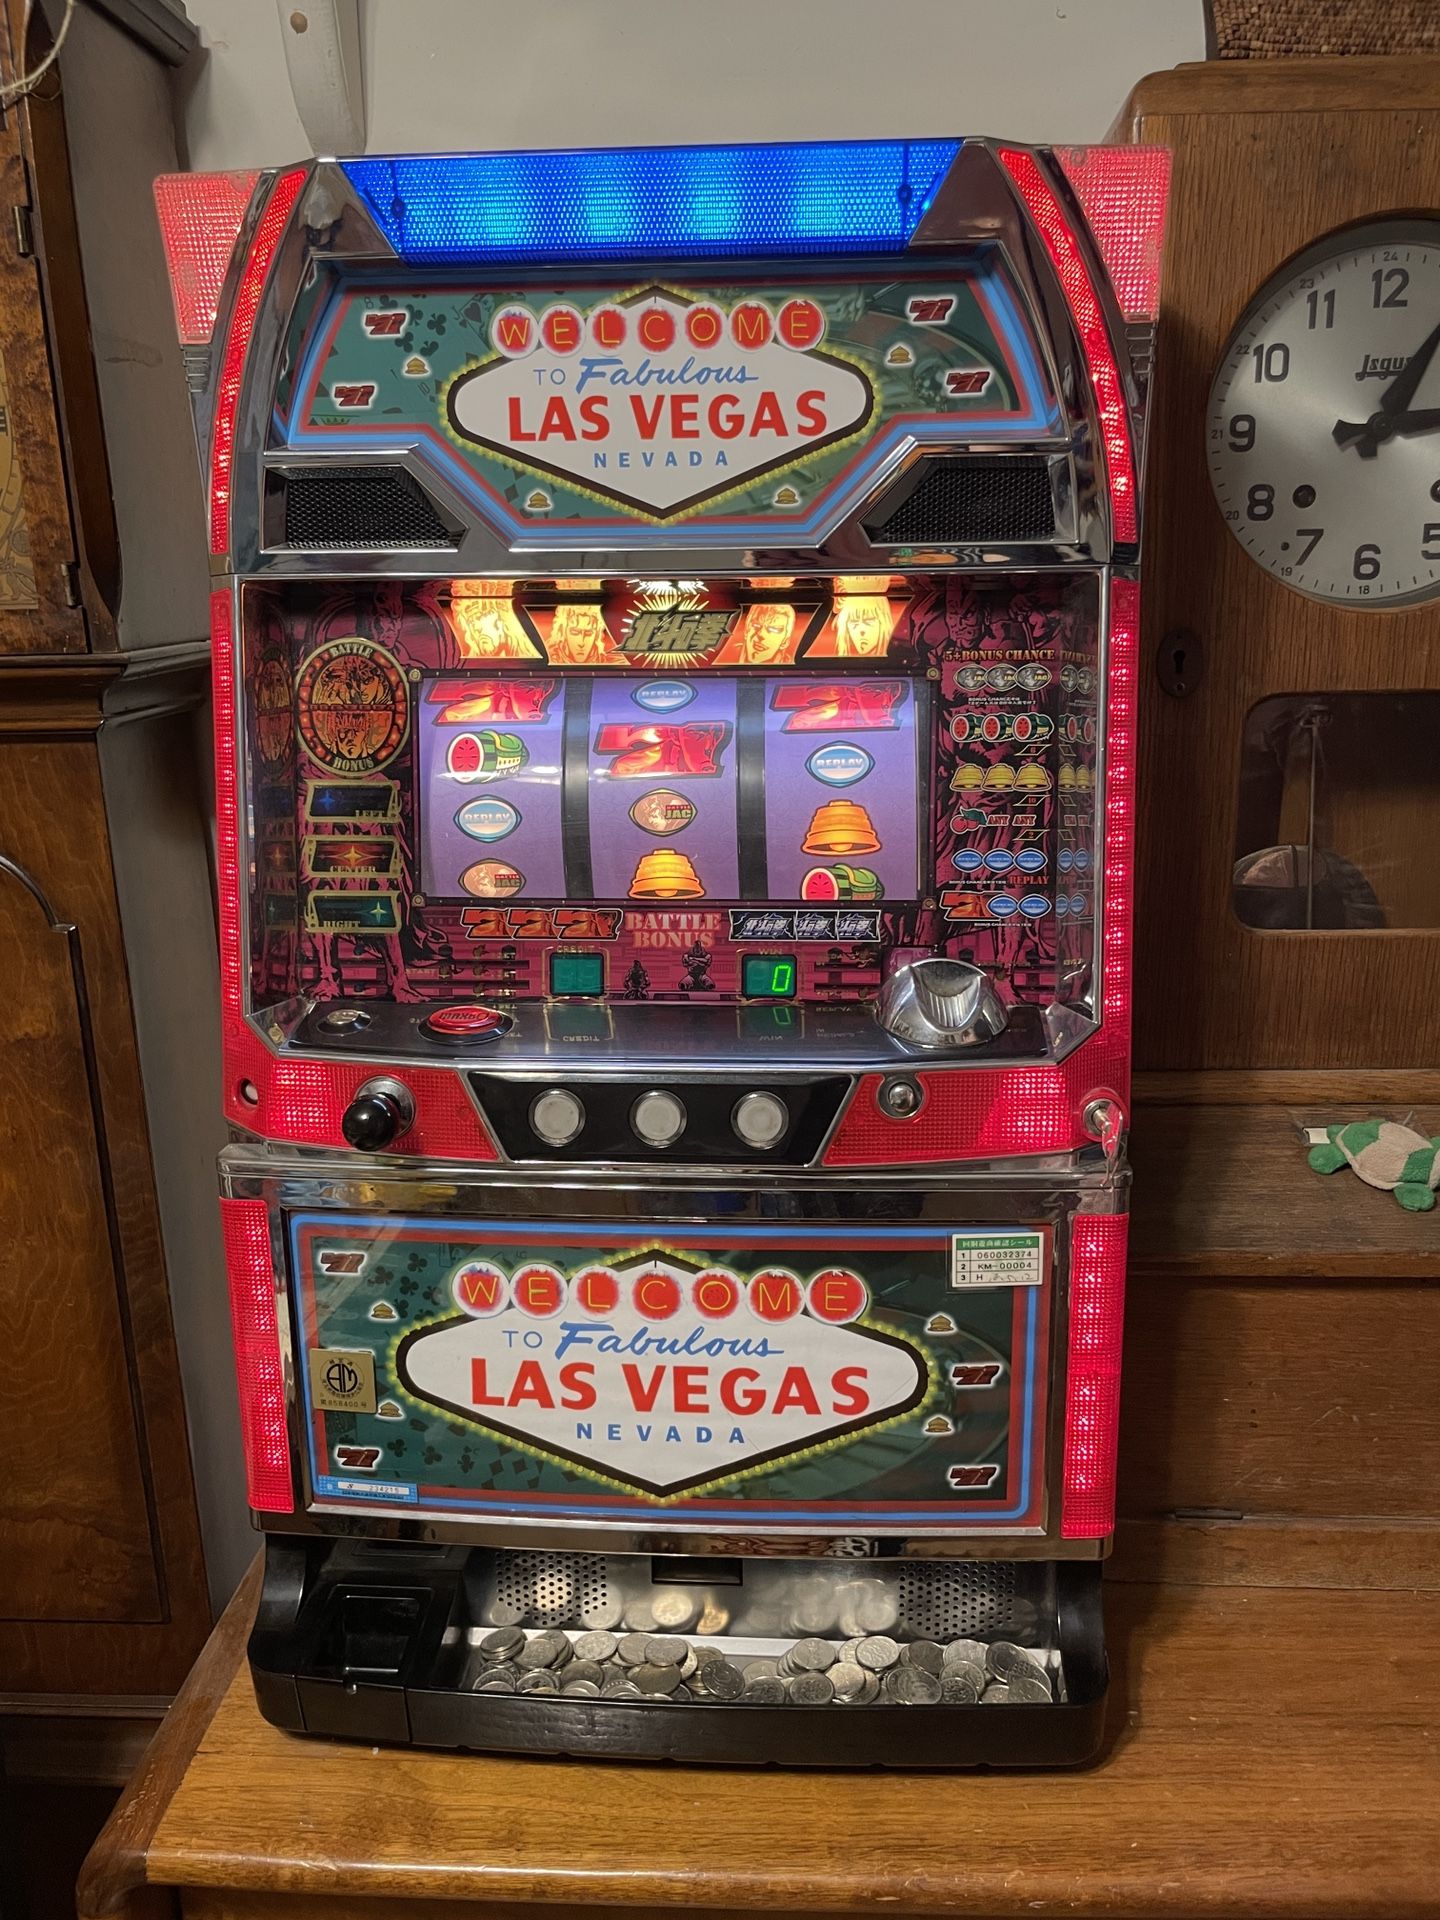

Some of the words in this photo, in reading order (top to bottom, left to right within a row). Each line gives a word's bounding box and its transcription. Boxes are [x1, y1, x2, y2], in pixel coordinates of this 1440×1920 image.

[1383, 251, 1398, 262] 24
[1300, 278, 1315, 289] 23
[1371, 267, 1410, 309] 12
[1306, 288, 1336, 330] 11
[498, 308, 812, 349] WELCOME
[1236, 344, 1250, 355] 22
[1252, 342, 1291, 384] 10
[532, 368, 567, 387] TO
[575, 356, 760, 395] Fabulous
[508, 395, 611, 443] LAS
[628, 389, 828, 441] VEGAS
[1211, 429, 1224, 440] 21
[1227, 413, 1257, 453] 9
[593, 450, 729, 469] NEVADA
[1246, 483, 1275, 522] 8
[1225, 510, 1240, 521] 20
[1294, 528, 1325, 567] 7
[1352, 543, 1382, 581] 6
[1280, 566, 1293, 577] 19
[1358, 585, 1370, 596] 18
[329, 643, 374, 659] BATTLE
[1005, 649, 1055, 661] CHANCE
[333, 756, 375, 771] BONUS
[815, 758, 865, 770] REPLAY
[665, 809, 692, 819] JAC
[329, 865, 377, 873] CENTER
[1008, 875, 1050, 885] REPLAY
[625, 911, 722, 930] BATTLE
[632, 931, 716, 948] BONUS
[772, 965, 791, 992] 0
[977, 1250, 1032, 1259] 060032374
[977, 1262, 1032, 1270] KM-00004
[460, 1273, 849, 1314] WELCOME
[501, 1329, 543, 1350] TO
[554, 1320, 785, 1361] Fabulous
[470, 1357, 597, 1411] LAS
[621, 1363, 871, 1417] VEGAS
[576, 1422, 745, 1445] NEVADA
